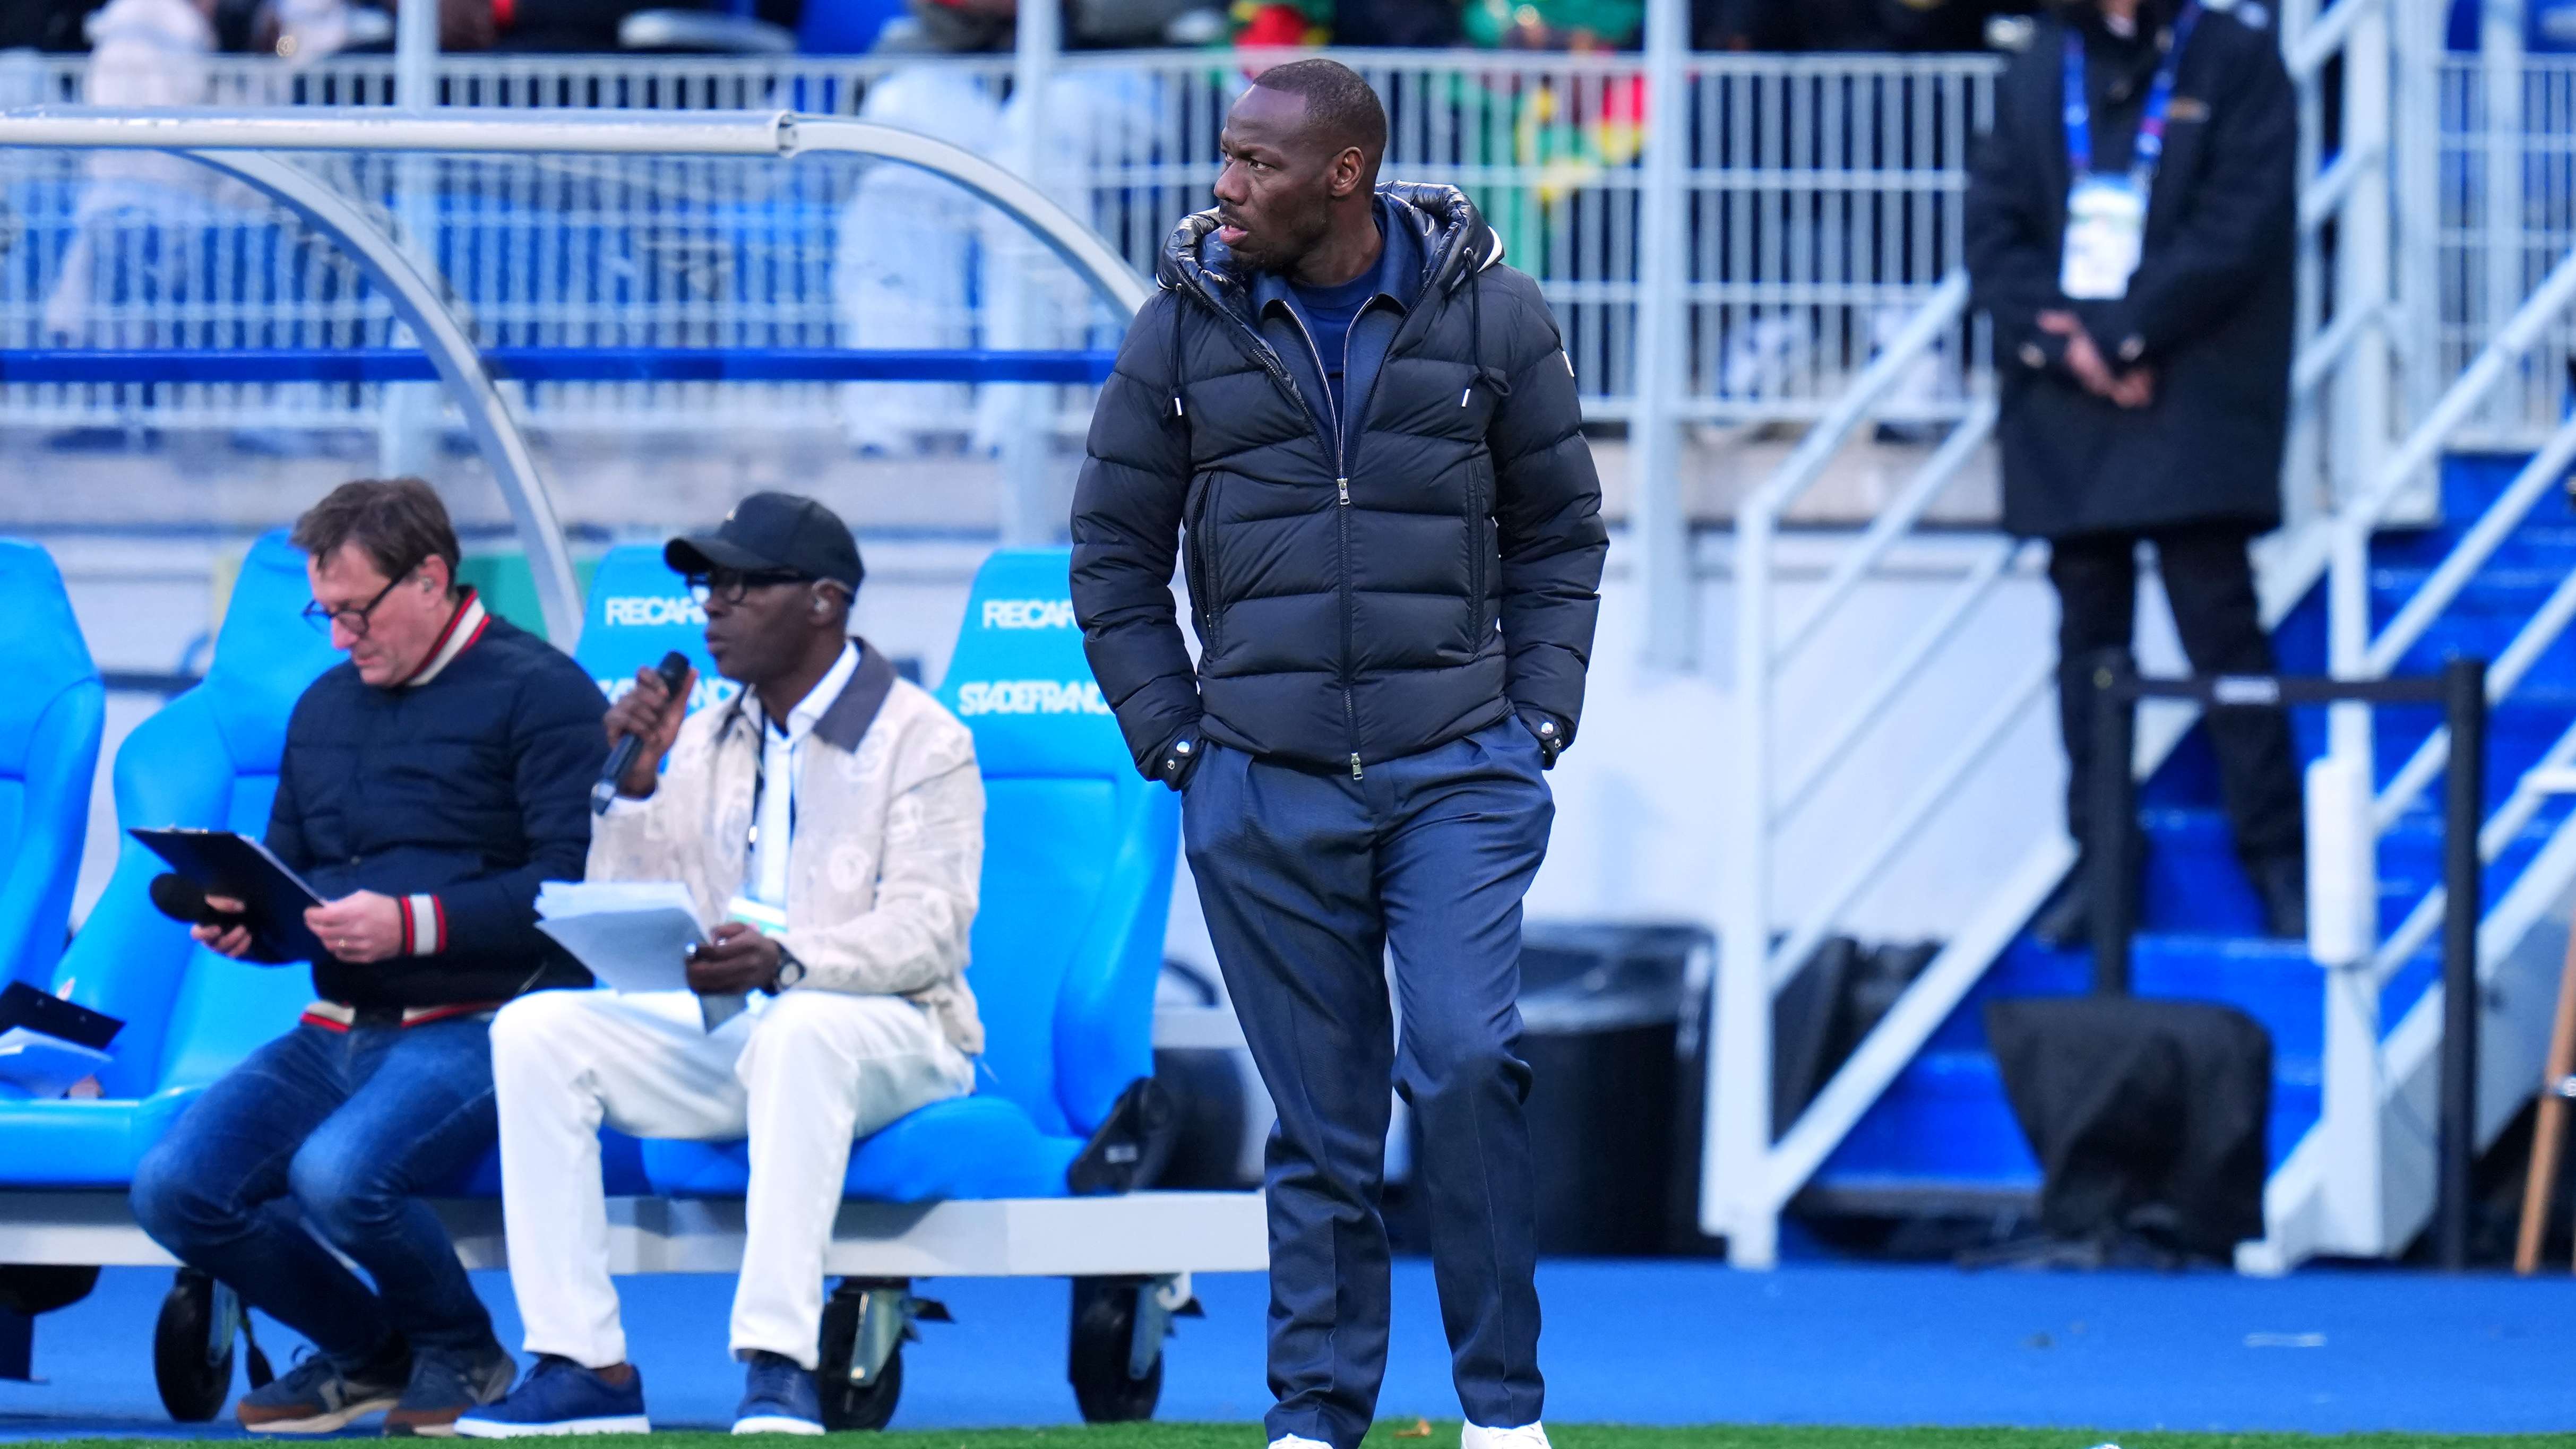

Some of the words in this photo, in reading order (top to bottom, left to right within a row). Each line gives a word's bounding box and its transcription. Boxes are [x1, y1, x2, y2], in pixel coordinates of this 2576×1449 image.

[605, 596, 709, 626] RECAR
[983, 600, 1076, 628] RECAR
[958, 680, 1112, 715] STADEFRANC
